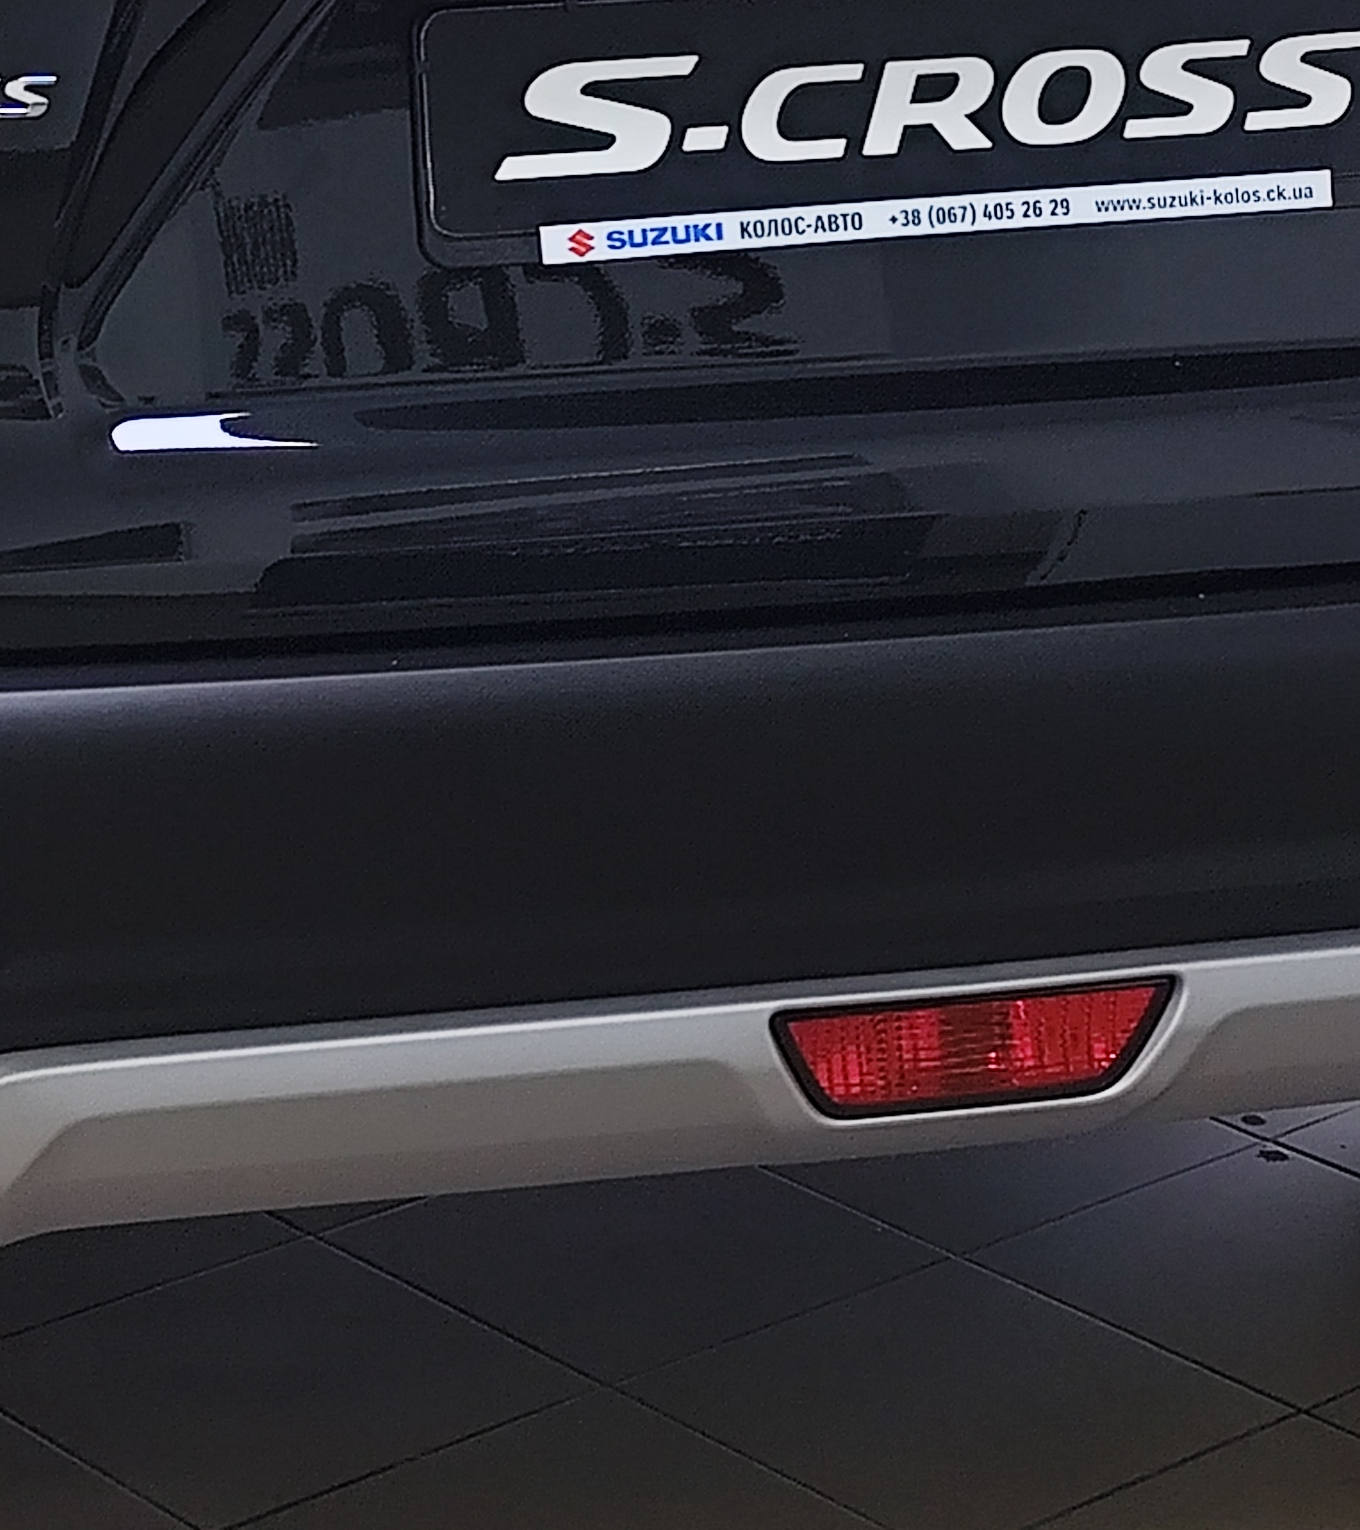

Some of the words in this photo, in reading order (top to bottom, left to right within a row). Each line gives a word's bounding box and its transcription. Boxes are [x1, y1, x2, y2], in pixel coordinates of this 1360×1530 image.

[606, 222, 724, 250] SUZUKI
[739, 212, 864, 240] КОЛОС-АВТО
[888, 208, 921, 229] +38
[928, 203, 977, 229] (067)
[983, 202, 1015, 222] 405
[1022, 199, 1043, 220] 26
[1049, 198, 1071, 217] 29
[1095, 185, 1314, 214] www.suzuki-kolos.ck.ua
